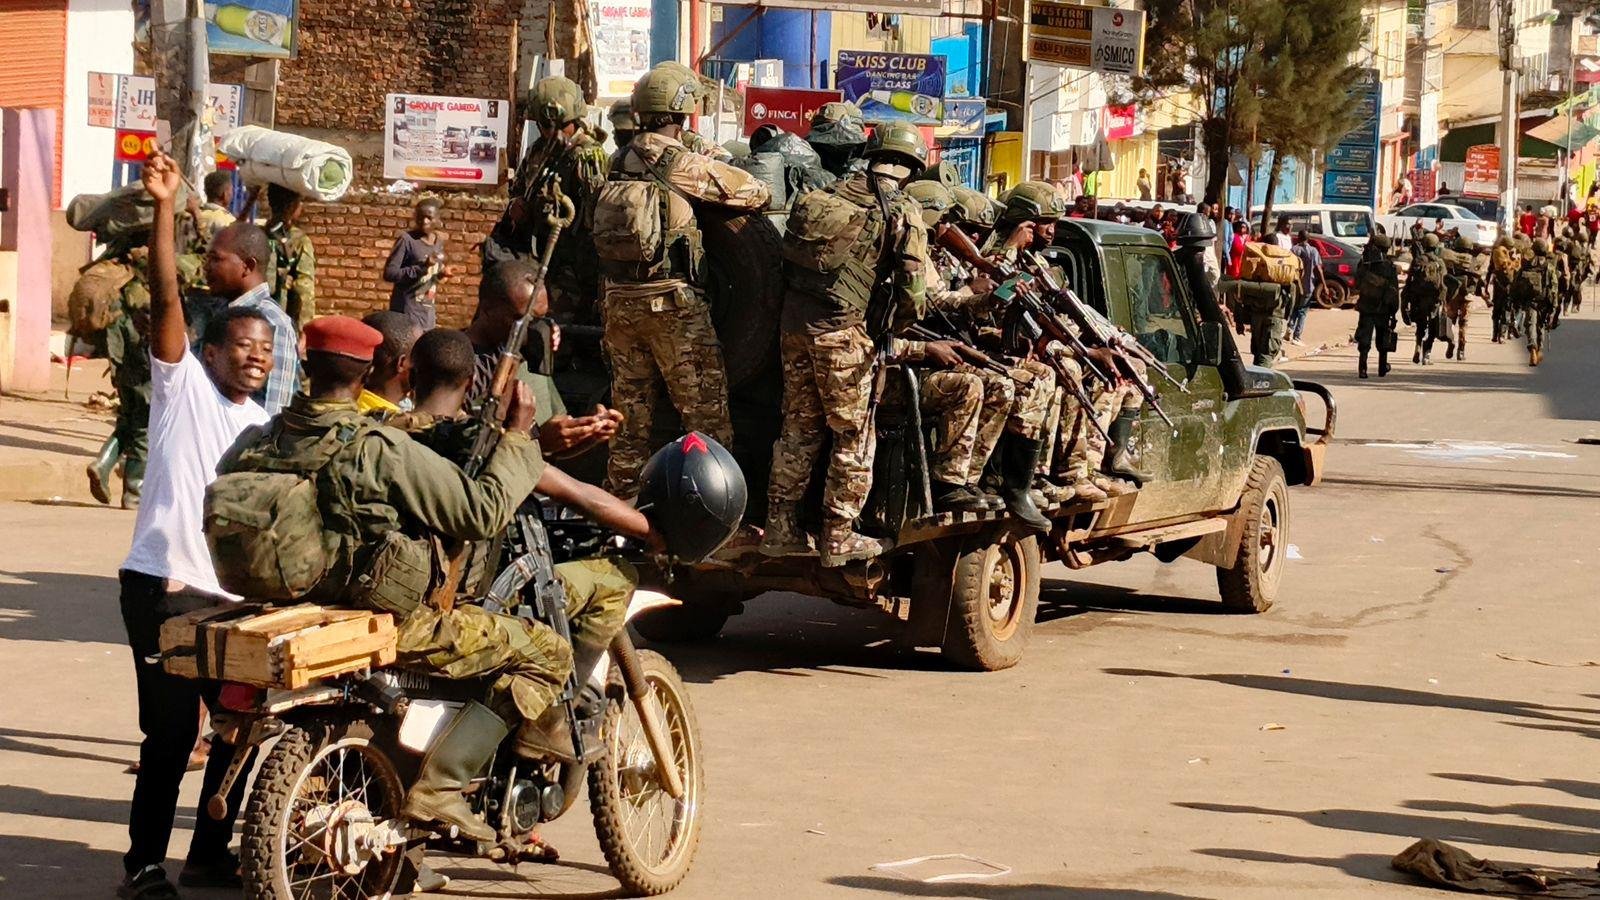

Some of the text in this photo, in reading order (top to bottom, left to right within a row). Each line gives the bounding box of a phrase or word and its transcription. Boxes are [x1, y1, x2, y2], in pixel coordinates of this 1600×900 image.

[1032, 5, 1084, 18] WESTERN
[1048, 17, 1084, 28] UNION
[1104, 45, 1135, 64] SMICO
[855, 55, 926, 70] KISS CLUB
[885, 80, 911, 89] CLASS
[409, 100, 445, 111] GROUPE
[768, 109, 798, 119] FINCA
